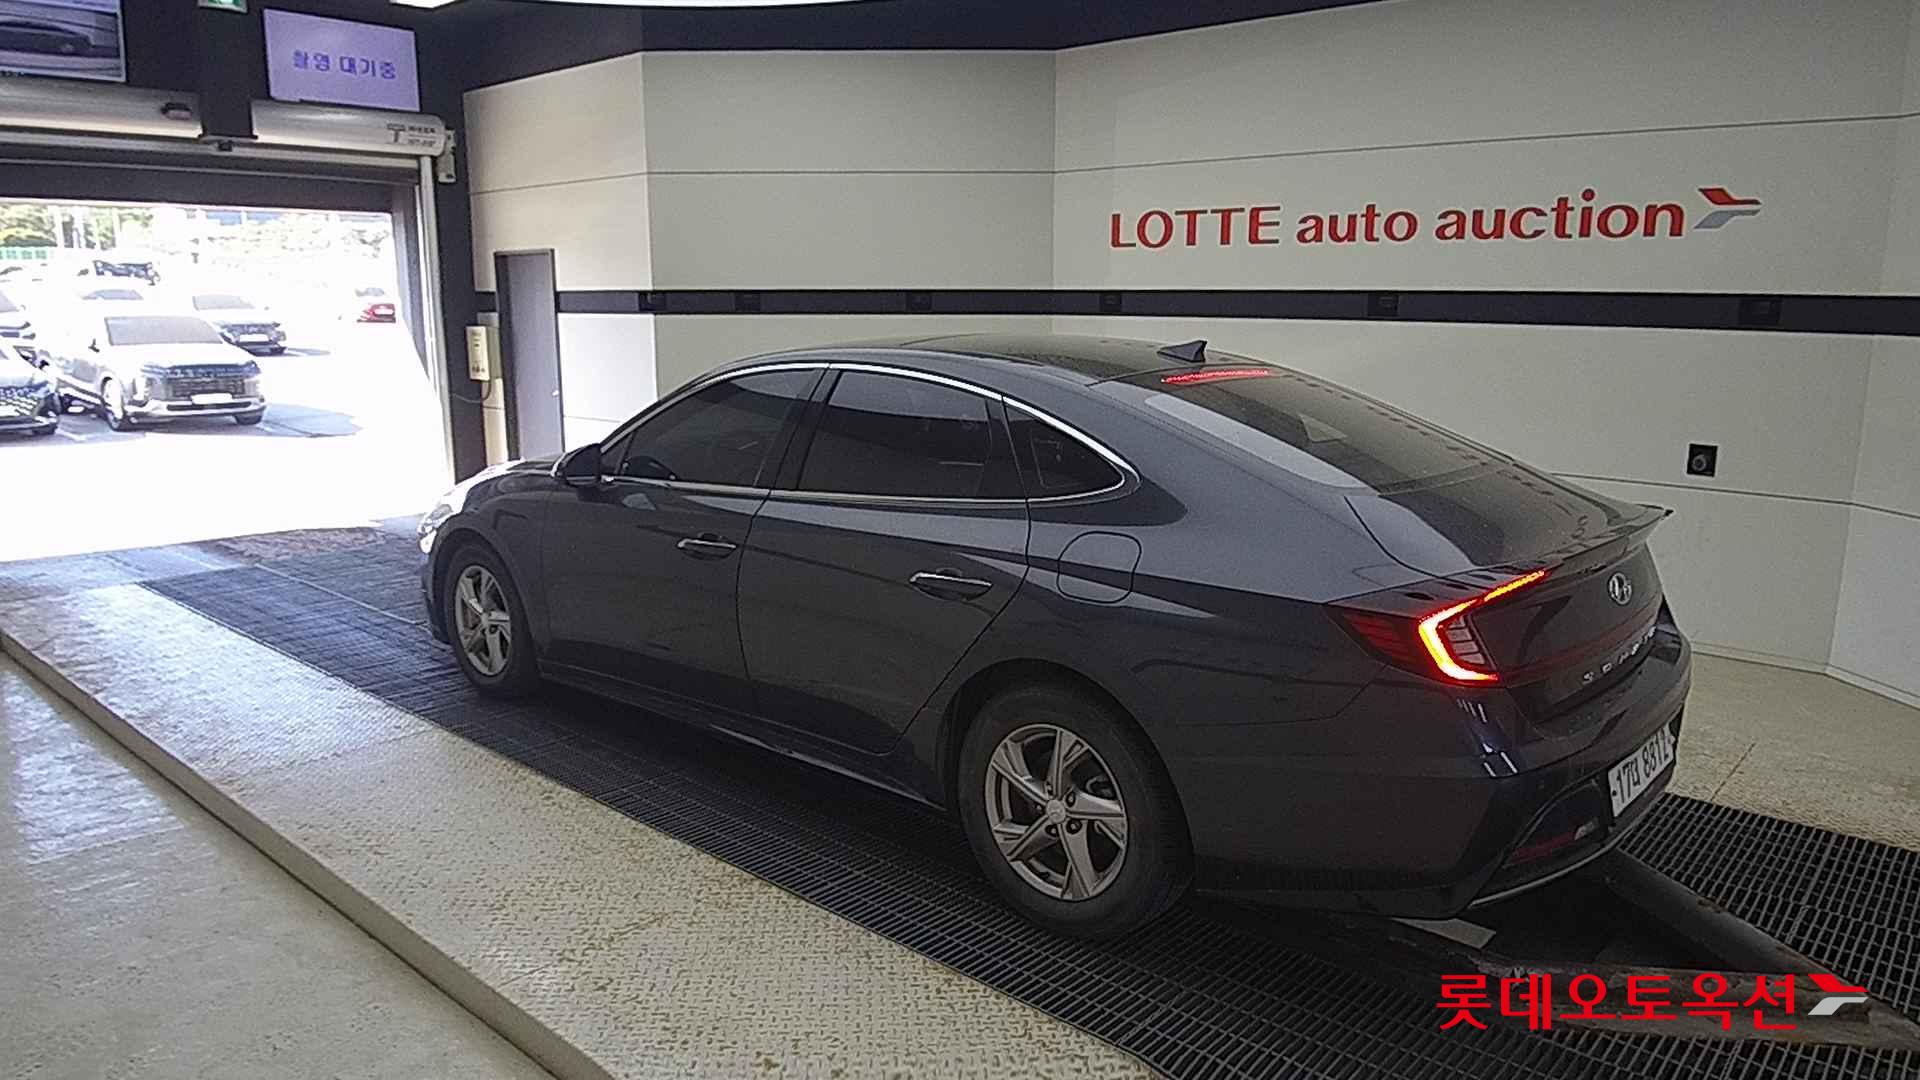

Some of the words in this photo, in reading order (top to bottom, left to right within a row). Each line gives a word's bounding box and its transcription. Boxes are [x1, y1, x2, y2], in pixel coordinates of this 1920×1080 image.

[339, 55, 397, 80] 대기중
[1110, 206, 1280, 248] LOTTE
[1296, 203, 1418, 243] auto
[1434, 188, 1685, 241] auction
